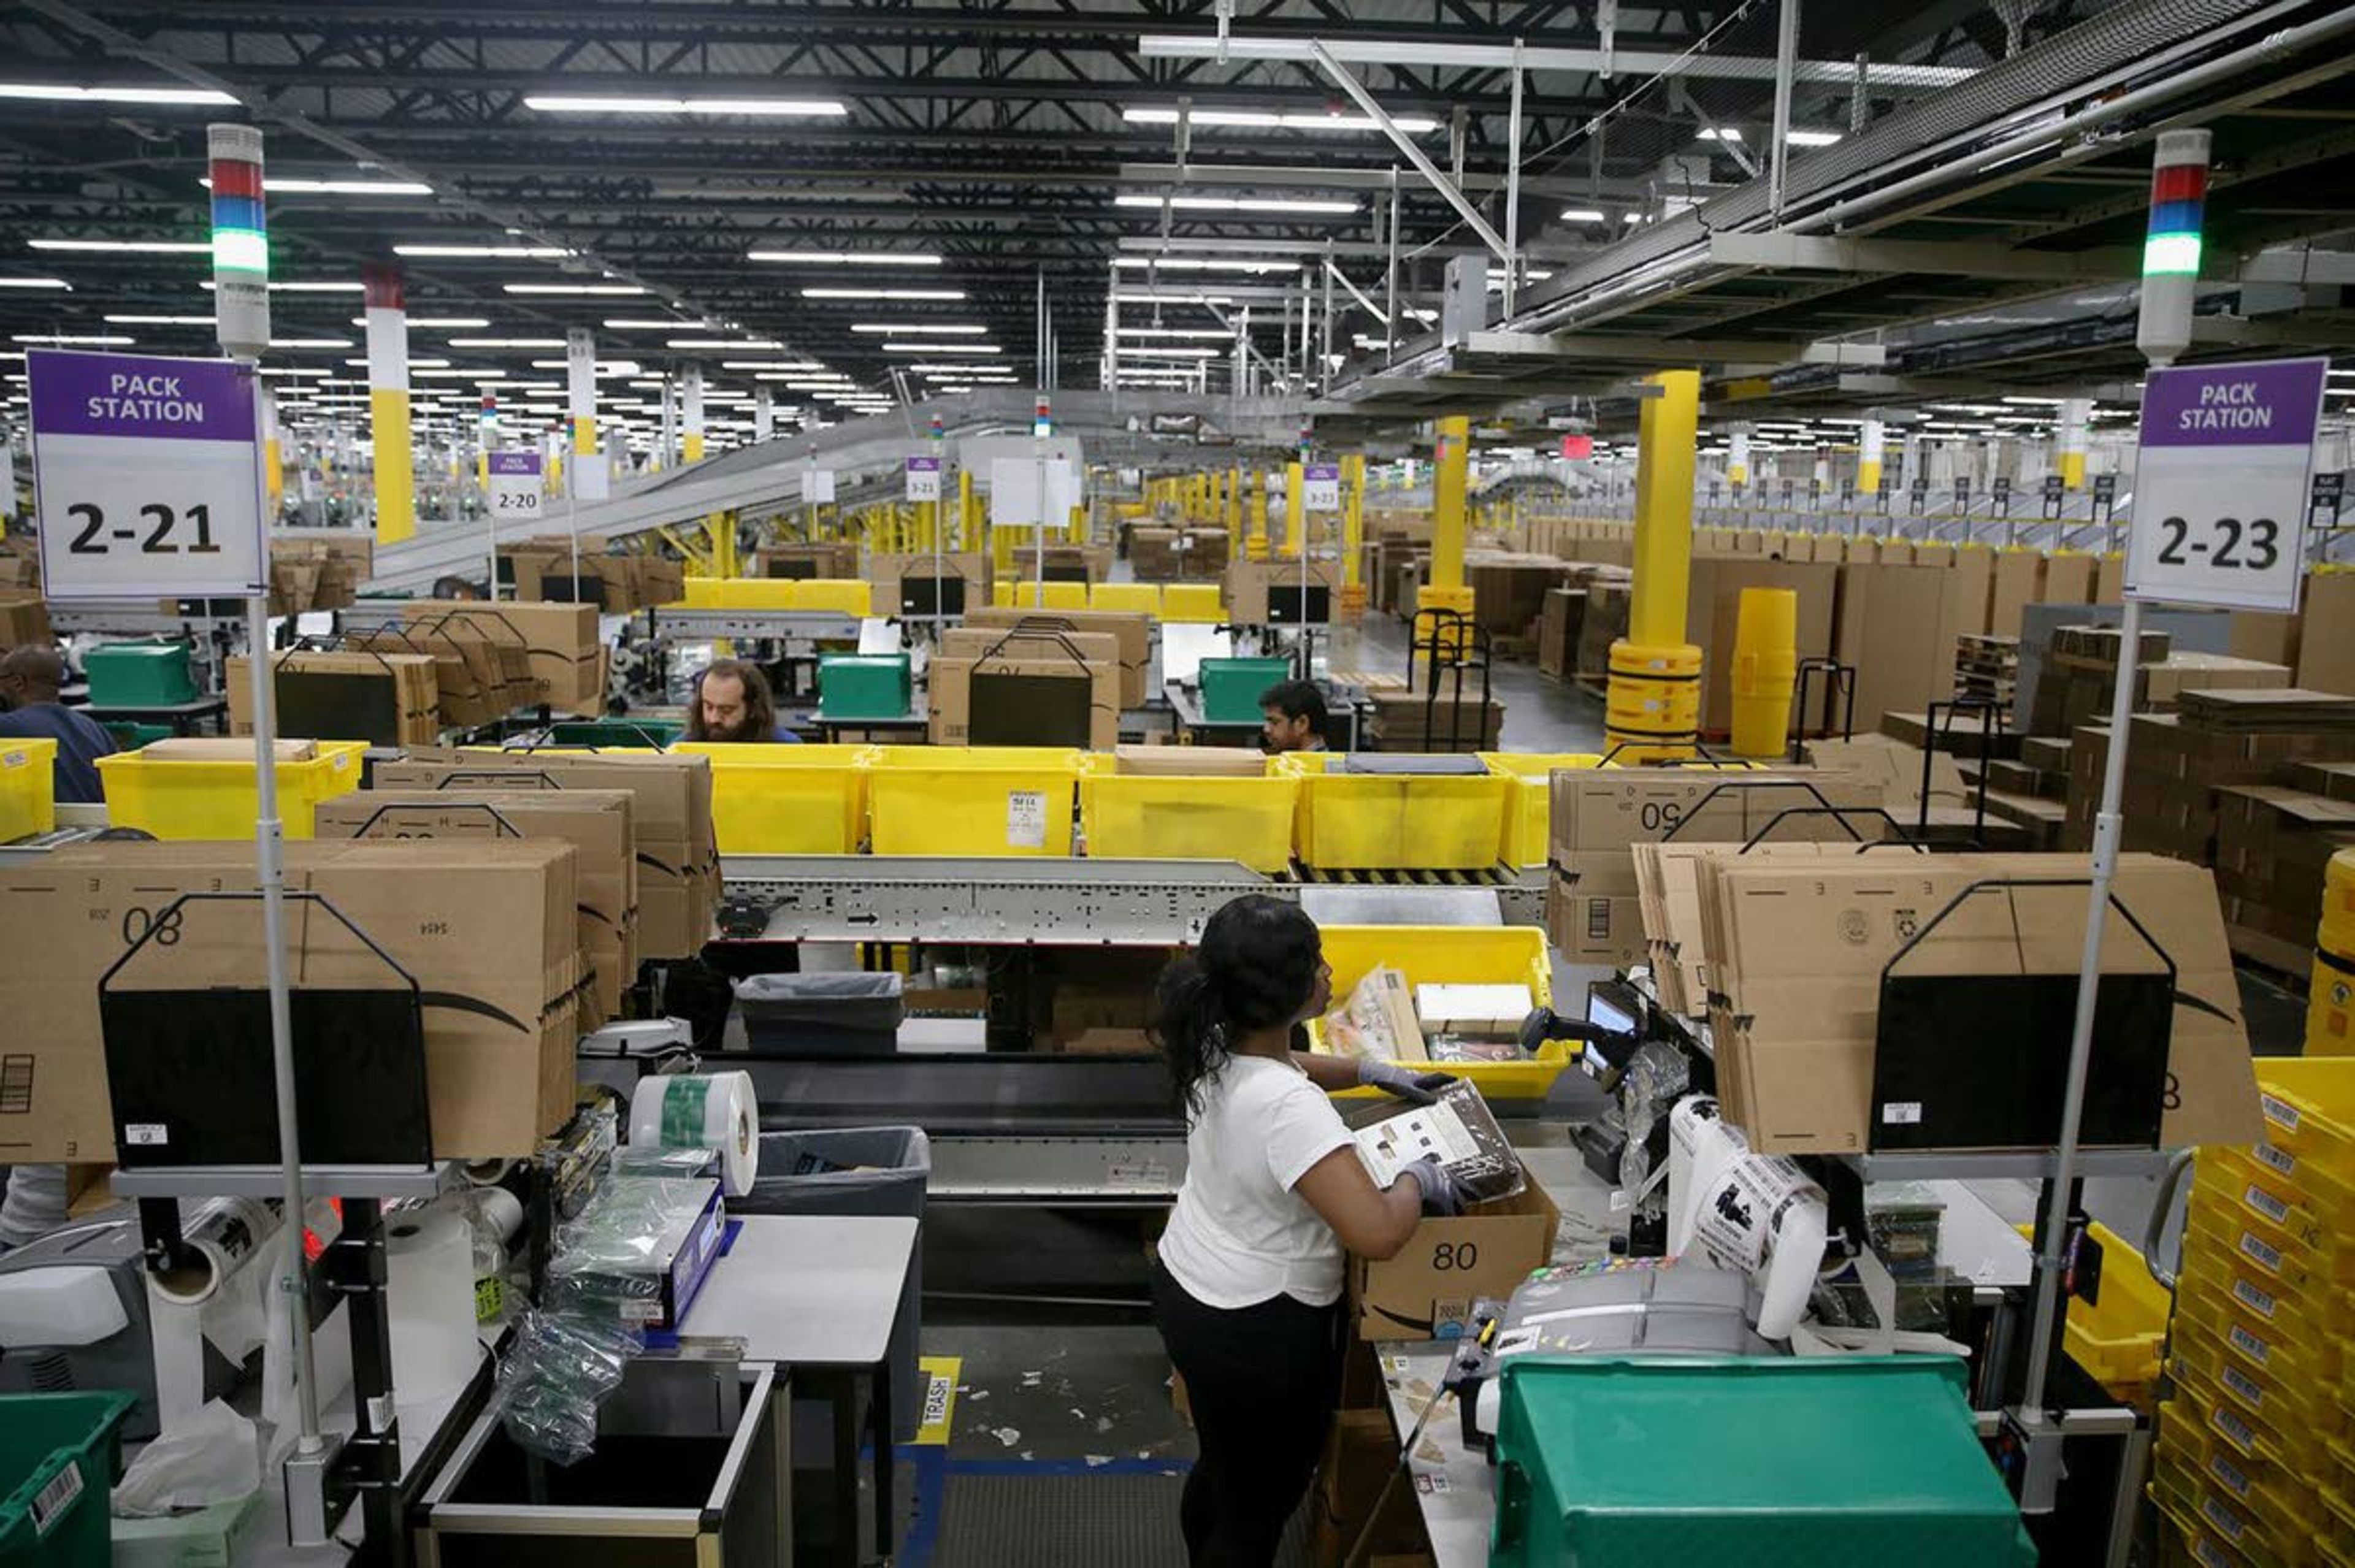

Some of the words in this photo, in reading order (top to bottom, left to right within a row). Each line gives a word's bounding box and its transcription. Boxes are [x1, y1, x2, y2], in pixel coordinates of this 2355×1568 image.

[110, 374, 183, 397] PACK
[2200, 382, 2257, 405] PACK
[88, 397, 204, 422] STATION
[2179, 406, 2272, 429] STATION
[499, 492, 537, 508] 2-20
[68, 503, 221, 554] 2-21
[2158, 516, 2278, 570] 2-23
[1641, 803, 1681, 831] 50
[123, 906, 183, 946] 80
[1433, 1242, 1477, 1271] 80
[925, 1380, 948, 1420] TRASH
